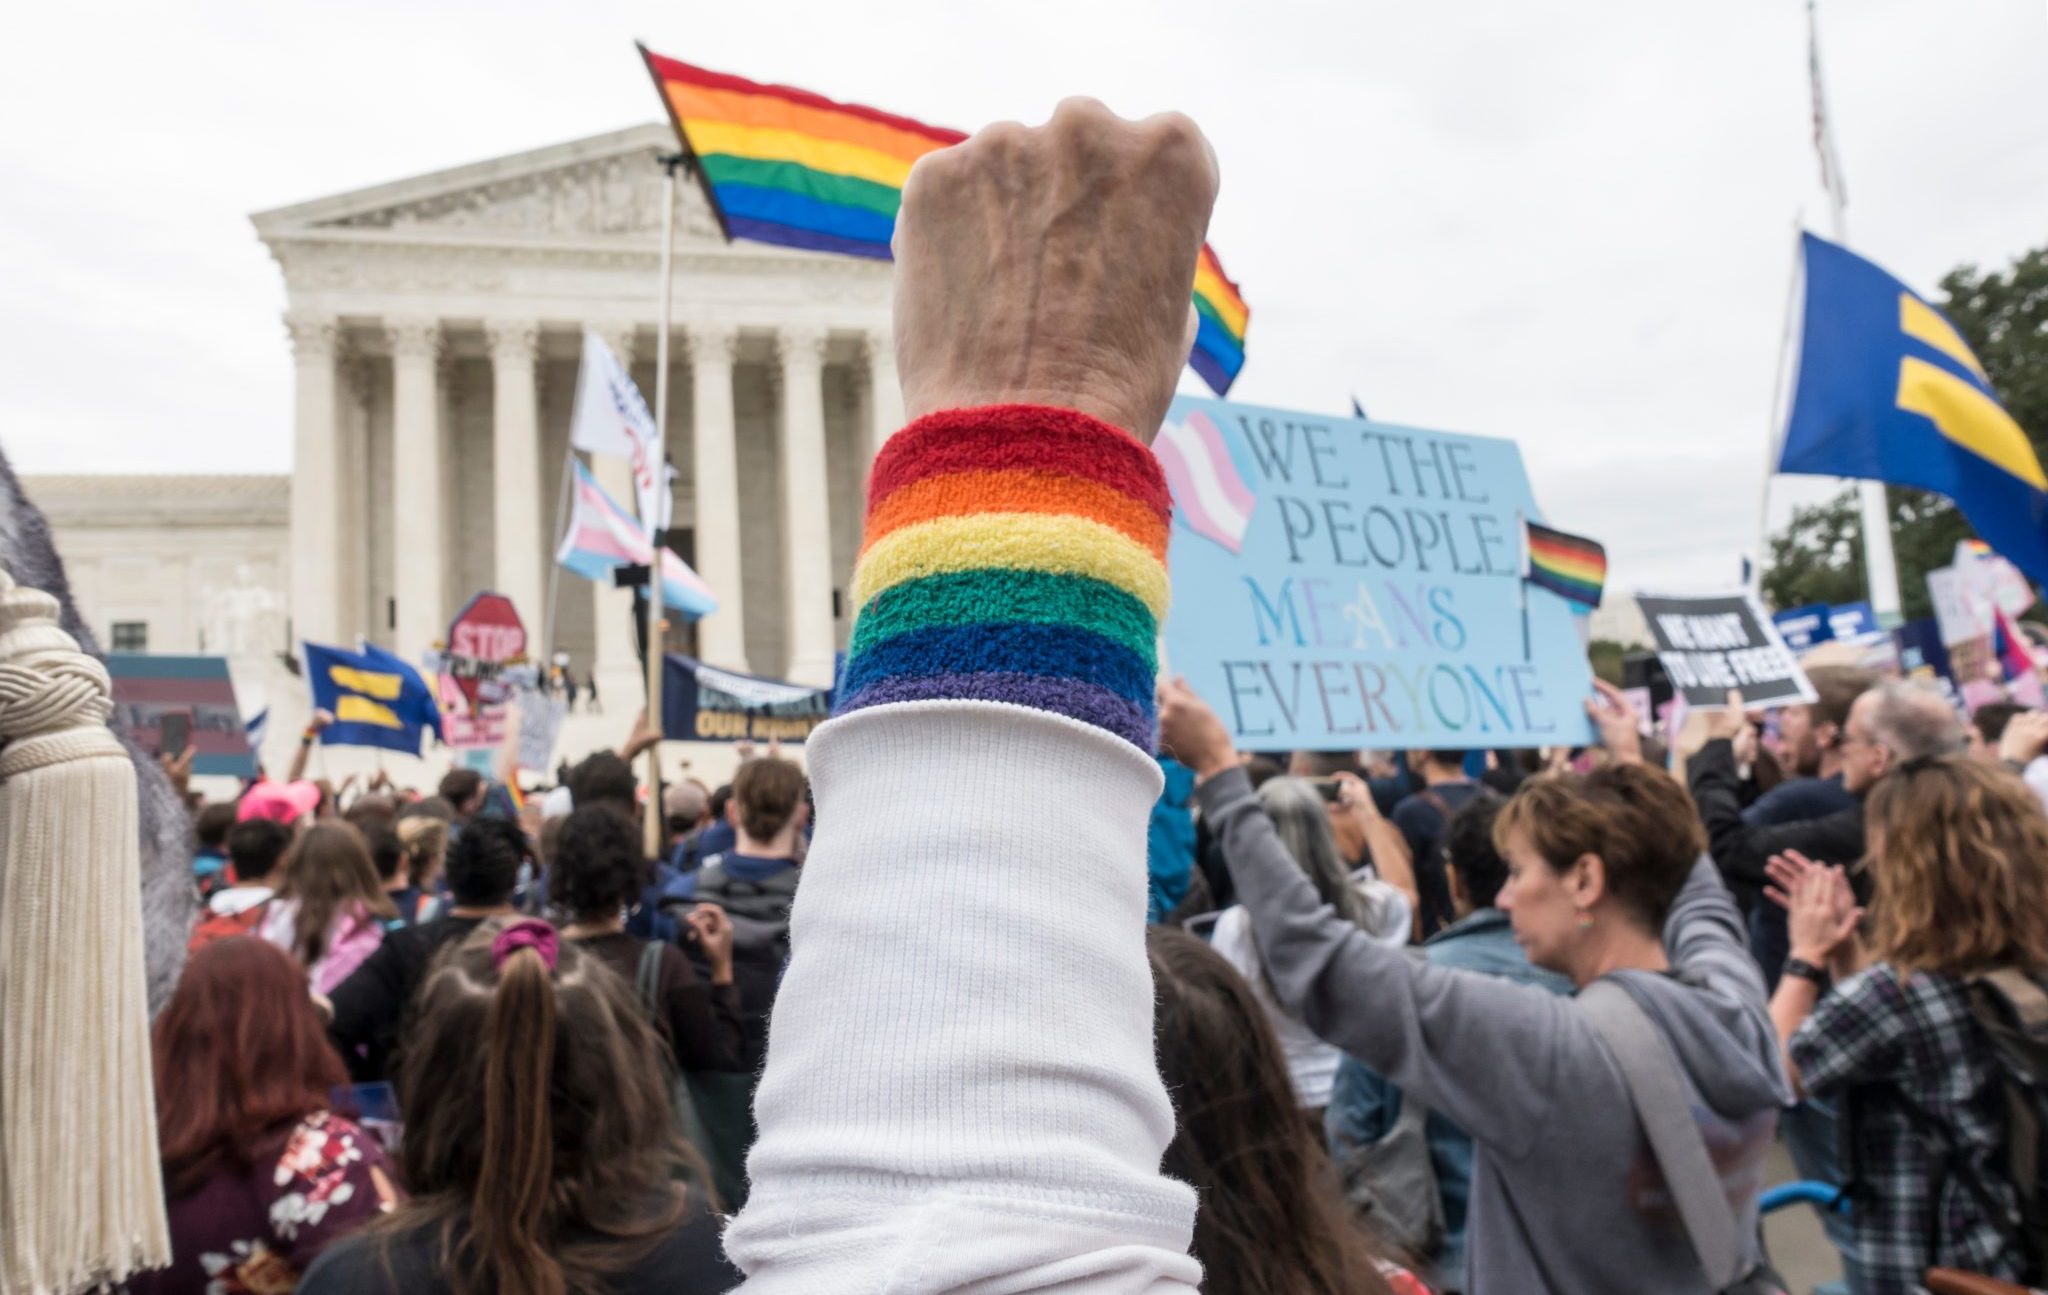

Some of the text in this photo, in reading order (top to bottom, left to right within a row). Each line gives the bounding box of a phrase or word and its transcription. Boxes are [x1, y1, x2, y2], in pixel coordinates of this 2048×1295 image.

[1238, 415, 1489, 505] WE THE
[1275, 496, 1516, 577] PEOPLE
[452, 620, 525, 661] STOP
[1242, 575, 1466, 653] MEANS
[1656, 612, 1697, 650] WE
[695, 708, 749, 738] OUR
[1220, 660, 1556, 737] EVERYONE
